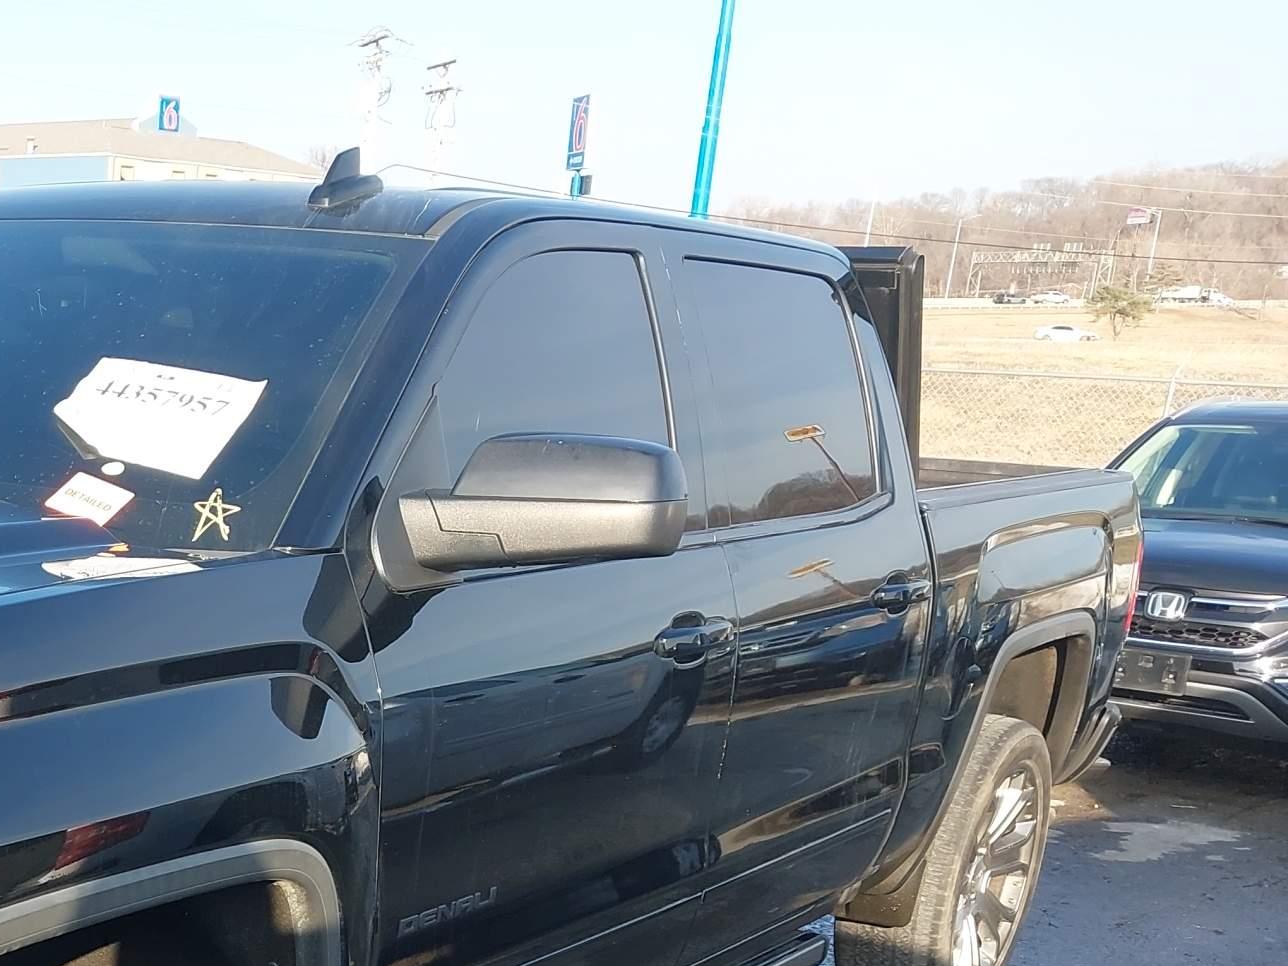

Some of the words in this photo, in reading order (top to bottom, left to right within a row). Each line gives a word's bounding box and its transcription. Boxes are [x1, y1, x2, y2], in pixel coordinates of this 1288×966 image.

[164, 100, 178, 130] 6
[96, 380, 230, 415] 44357957
[64, 488, 112, 512] DETAILED
[397, 886, 497, 938] DENALI
